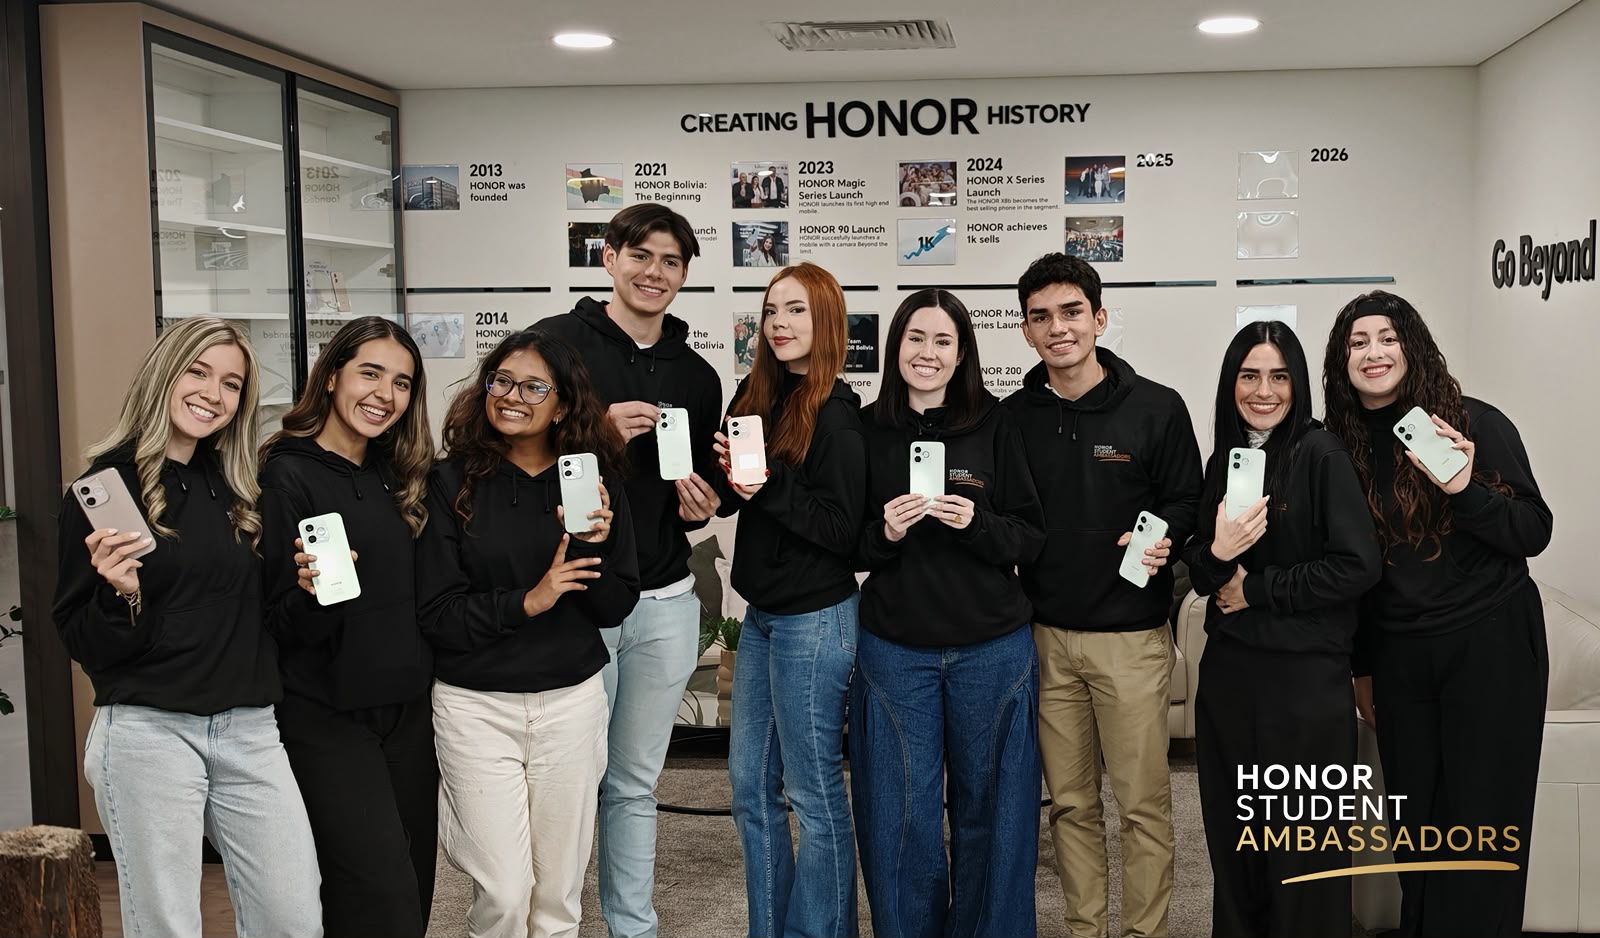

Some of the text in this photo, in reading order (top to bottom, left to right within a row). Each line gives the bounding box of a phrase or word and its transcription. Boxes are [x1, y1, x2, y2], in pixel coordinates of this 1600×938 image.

[680, 98, 1091, 138] CREATING HONOR HISTORY
[1310, 148, 1349, 162] 2026
[634, 163, 667, 176] 2021
[798, 161, 834, 174] 2023
[966, 158, 1003, 171] 2024
[470, 163, 503, 177] 2013
[634, 180, 708, 189] HONOR Bolivia:
[798, 179, 866, 190] HONOR Magic
[966, 175, 1046, 185] HONOR X Series
[470, 181, 506, 190] HONOR
[470, 193, 508, 202] founded
[635, 192, 701, 203] The Beginning
[798, 190, 863, 200] Series Launch
[966, 188, 1001, 197] Launch
[694, 226, 717, 234] unch
[799, 225, 885, 234] HONOR 90 Launch
[966, 222, 1048, 232] HONOR achieves
[918, 236, 935, 248] 1K
[967, 235, 1000, 244] 1k sells
[1491, 219, 1597, 301] Go Beyond
[475, 312, 509, 325] 2014
[1005, 309, 1024, 319] Mag
[972, 320, 1023, 329] eries Launc
[693, 330, 709, 338] the
[693, 341, 724, 349] Bolivia
[982, 366, 1022, 375] NOR 200
